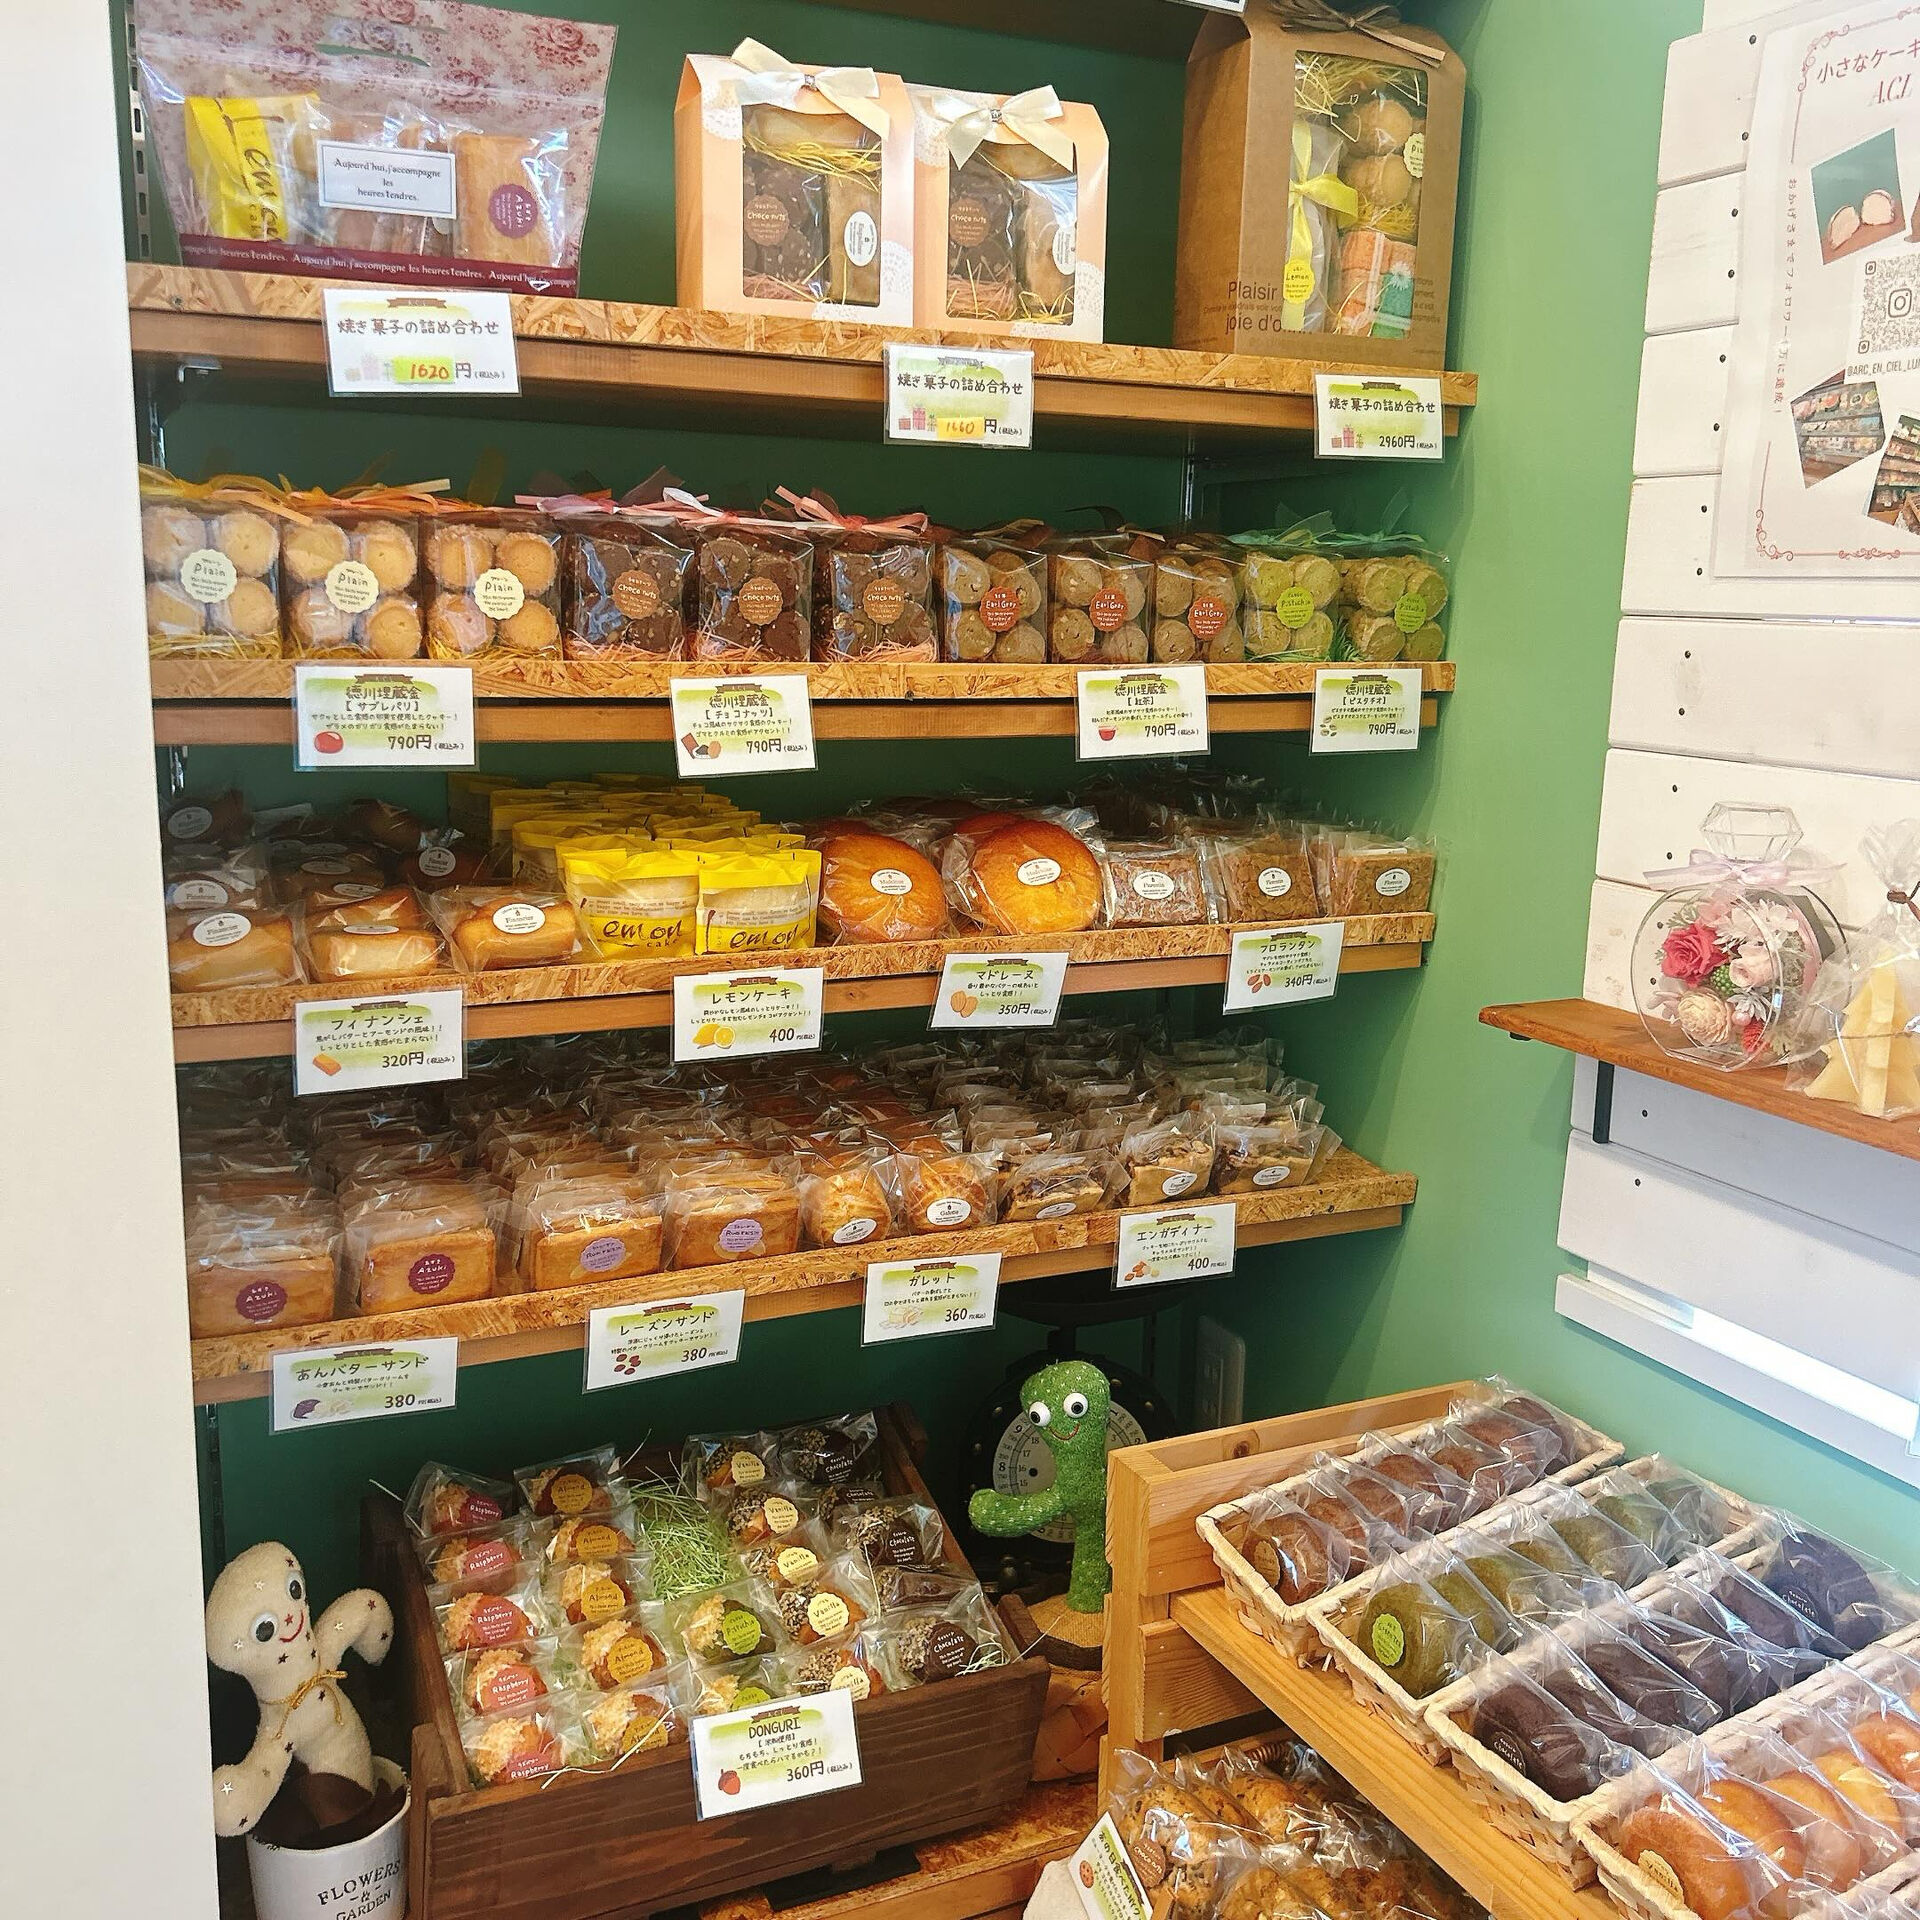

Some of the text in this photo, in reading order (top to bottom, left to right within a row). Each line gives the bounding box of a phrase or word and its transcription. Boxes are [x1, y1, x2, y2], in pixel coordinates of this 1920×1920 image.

[382, 178, 394, 188] les
[357, 187, 385, 198] heures
[409, 264, 420, 274] les
[422, 265, 450, 276] heures
[1228, 281, 1278, 301] Plaisir
[337, 317, 500, 336] 焼き菓子の詰め合わせ
[1225, 315, 1253, 335] joie
[410, 363, 450, 380] 1620
[455, 362, 472, 379] 円
[897, 373, 1024, 395] 焼き菓子の詰め合わせ
[1328, 397, 1436, 413] 焼き菓子の詰め合わせ
[984, 418, 997, 434] 円
[1379, 435, 1415, 449] 2960円
[193, 562, 226, 577] Plain
[338, 570, 368, 587] Plain
[484, 581, 514, 593] Plain
[345, 685, 422, 700] 徳川埋蔵金
[1114, 682, 1169, 697] 徳川埋蔵金
[1345, 684, 1393, 696] 徳川埋蔵金
[709, 693, 771, 708] 徳川埋蔵金
[1144, 723, 1176, 738] 790円
[1368, 722, 1396, 735] 790円
[387, 734, 432, 750] 790円
[746, 738, 782, 754] 790円
[1260, 940, 1316, 954] フロランタン
[976, 969, 1034, 981] マドレーヌ
[1284, 973, 1313, 988] 340円
[712, 987, 791, 1005] レモンケーキ
[998, 1003, 1030, 1015] 350円
[331, 1015, 424, 1031] フィナンシェ
[769, 1027, 795, 1043] 400
[382, 1051, 424, 1068] 320円
[1136, 1223, 1213, 1242] エンガディナー
[1187, 1256, 1210, 1271] 400
[909, 1272, 956, 1287] ガレット
[944, 1307, 968, 1323] 360
[620, 1310, 715, 1337] レーズンサンド
[681, 1347, 708, 1363] 380
[296, 1356, 430, 1381] あんバターサンド
[384, 1394, 416, 1409] 380
[998, 1461, 1006, 1472] 8
[888, 1535, 916, 1548] Chocolate
[469, 1552, 503, 1571] Raspberry
[782, 1552, 810, 1568] Vanilla
[477, 1609, 514, 1624] Raspberry
[813, 1601, 842, 1617] Vanilla
[933, 1634, 965, 1653] Chocolate
[614, 1648, 644, 1663] Almond
[491, 1677, 530, 1694] Raspberry
[748, 1716, 802, 1739] DONGURI
[510, 1763, 550, 1780] Raspberry
[786, 1760, 825, 1783] 360円
[317, 1858, 401, 1906] FLOWERS
[336, 1889, 392, 1920] GARDEN
